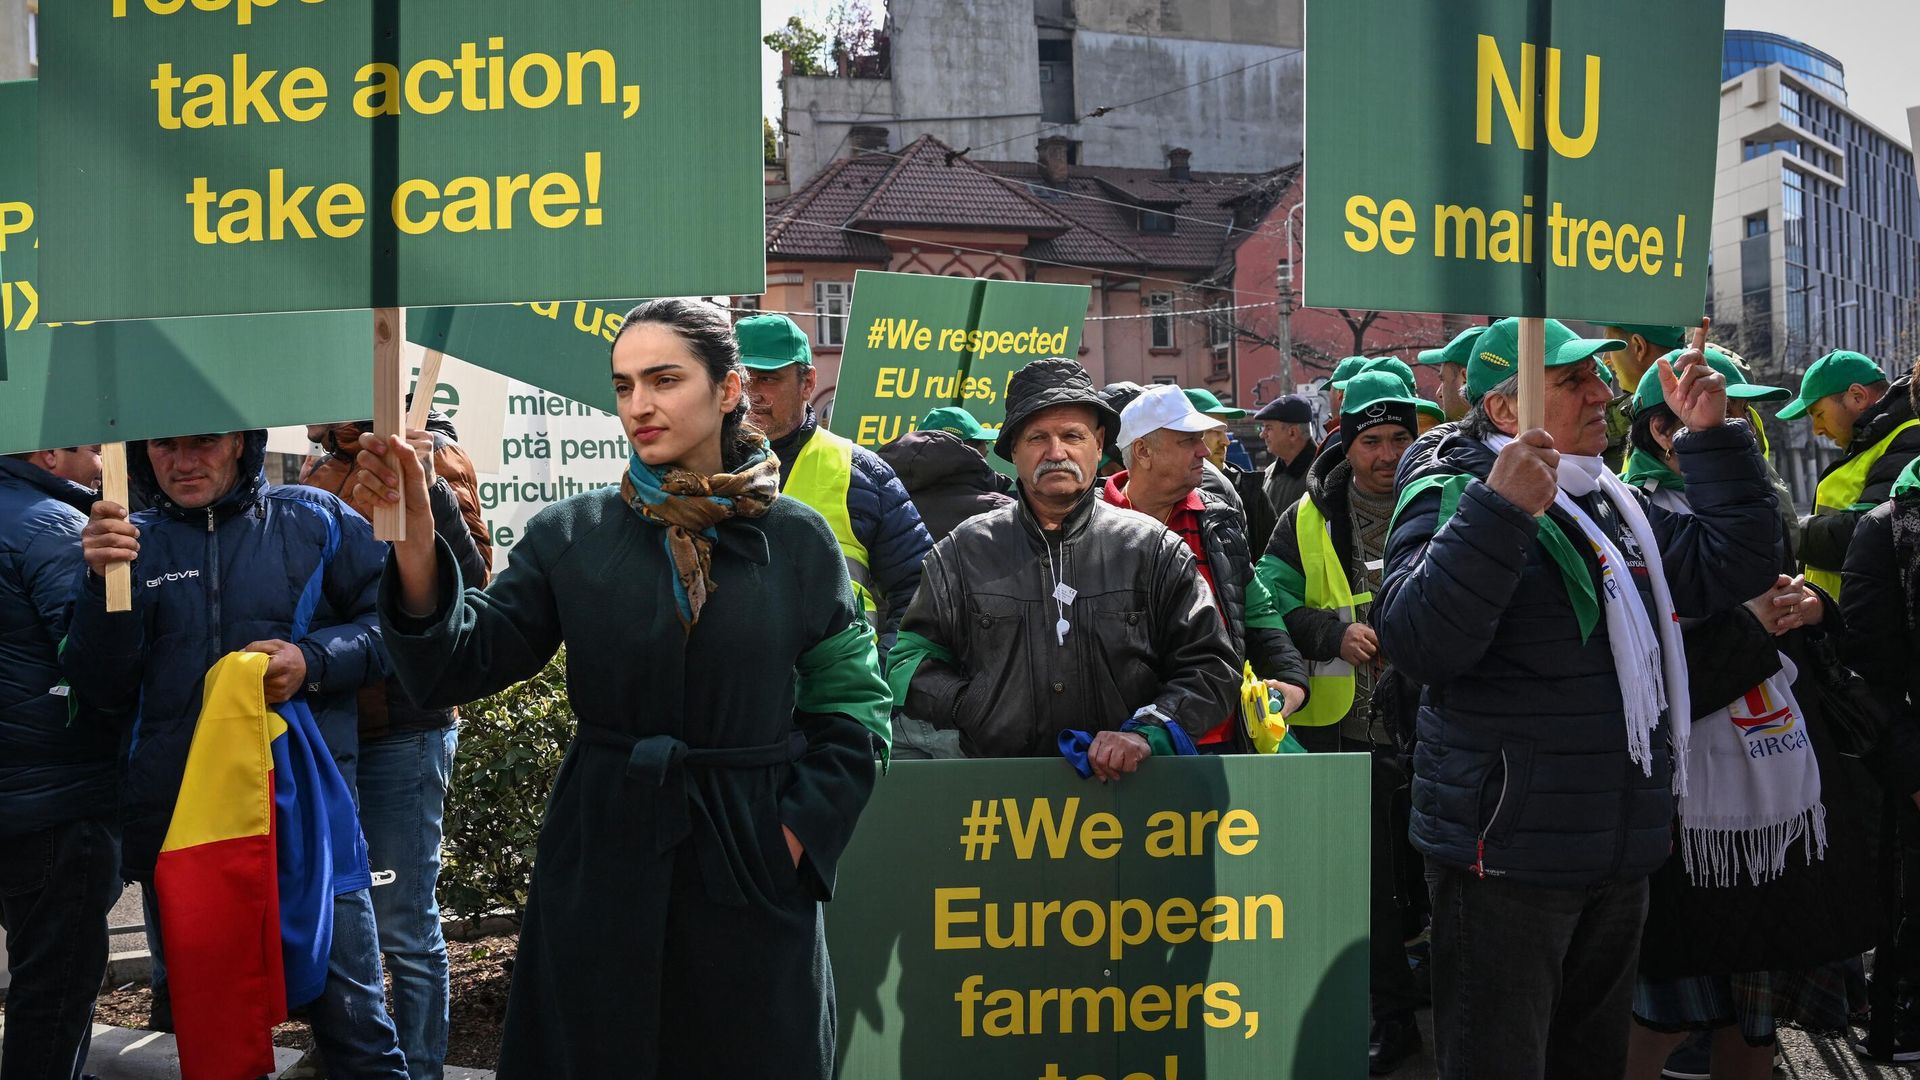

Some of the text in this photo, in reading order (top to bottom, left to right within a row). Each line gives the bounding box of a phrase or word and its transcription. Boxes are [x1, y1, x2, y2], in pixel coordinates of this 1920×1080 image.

[151, 37, 641, 129] take action,
[1476, 33, 1601, 158] NU
[186, 152, 603, 244] take care!
[1344, 195, 1417, 255] se
[1435, 195, 1533, 264] mai
[1547, 201, 1665, 276] trece
[868, 318, 1069, 360] #We respected
[875, 367, 920, 399] EU
[924, 370, 997, 404] rules,
[857, 415, 902, 446] EU
[146, 569, 199, 588] GIVOVA
[1748, 729, 1808, 759] ARCA
[958, 797, 1260, 862] #We are
[934, 886, 1285, 961] European
[954, 974, 1260, 1040] farmers,
